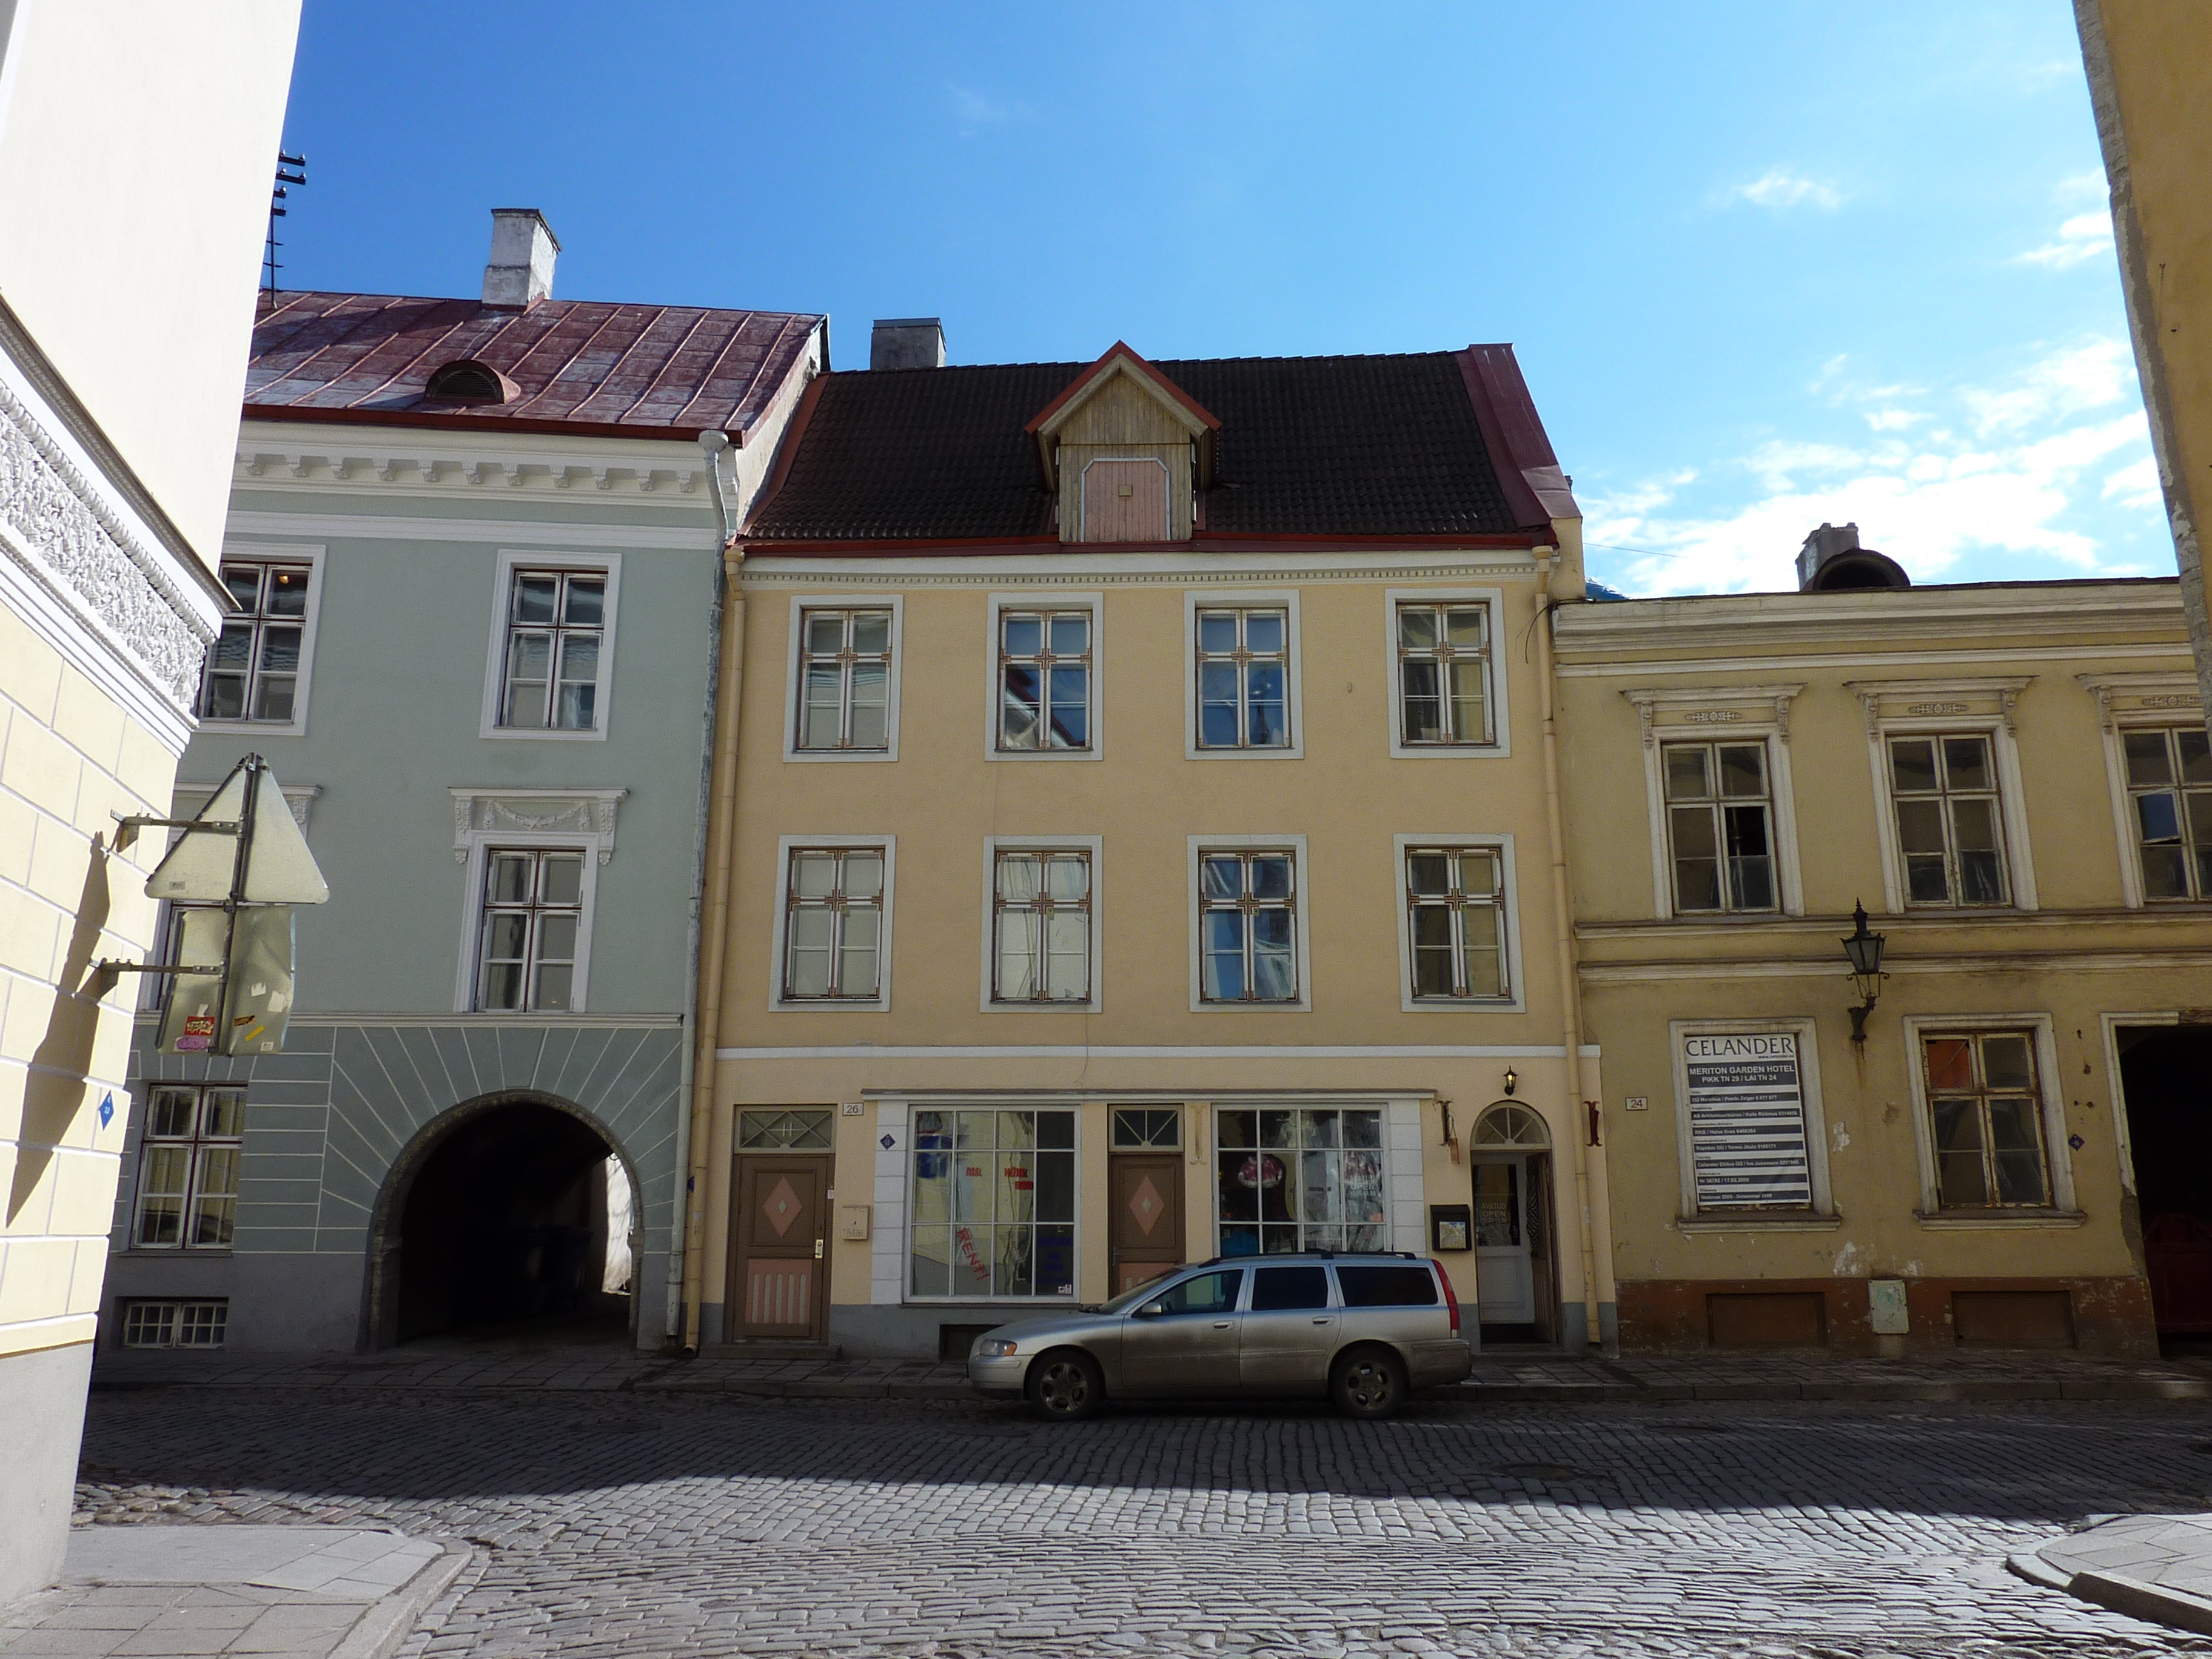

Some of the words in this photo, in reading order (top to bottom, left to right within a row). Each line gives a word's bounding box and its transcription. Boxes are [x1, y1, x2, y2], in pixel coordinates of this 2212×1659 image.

[1686, 1037, 1794, 1056] CELANDER
[846, 1105, 859, 1113] 26
[1631, 1099, 1642, 1108] 24
[956, 1227, 990, 1282] RENT!
